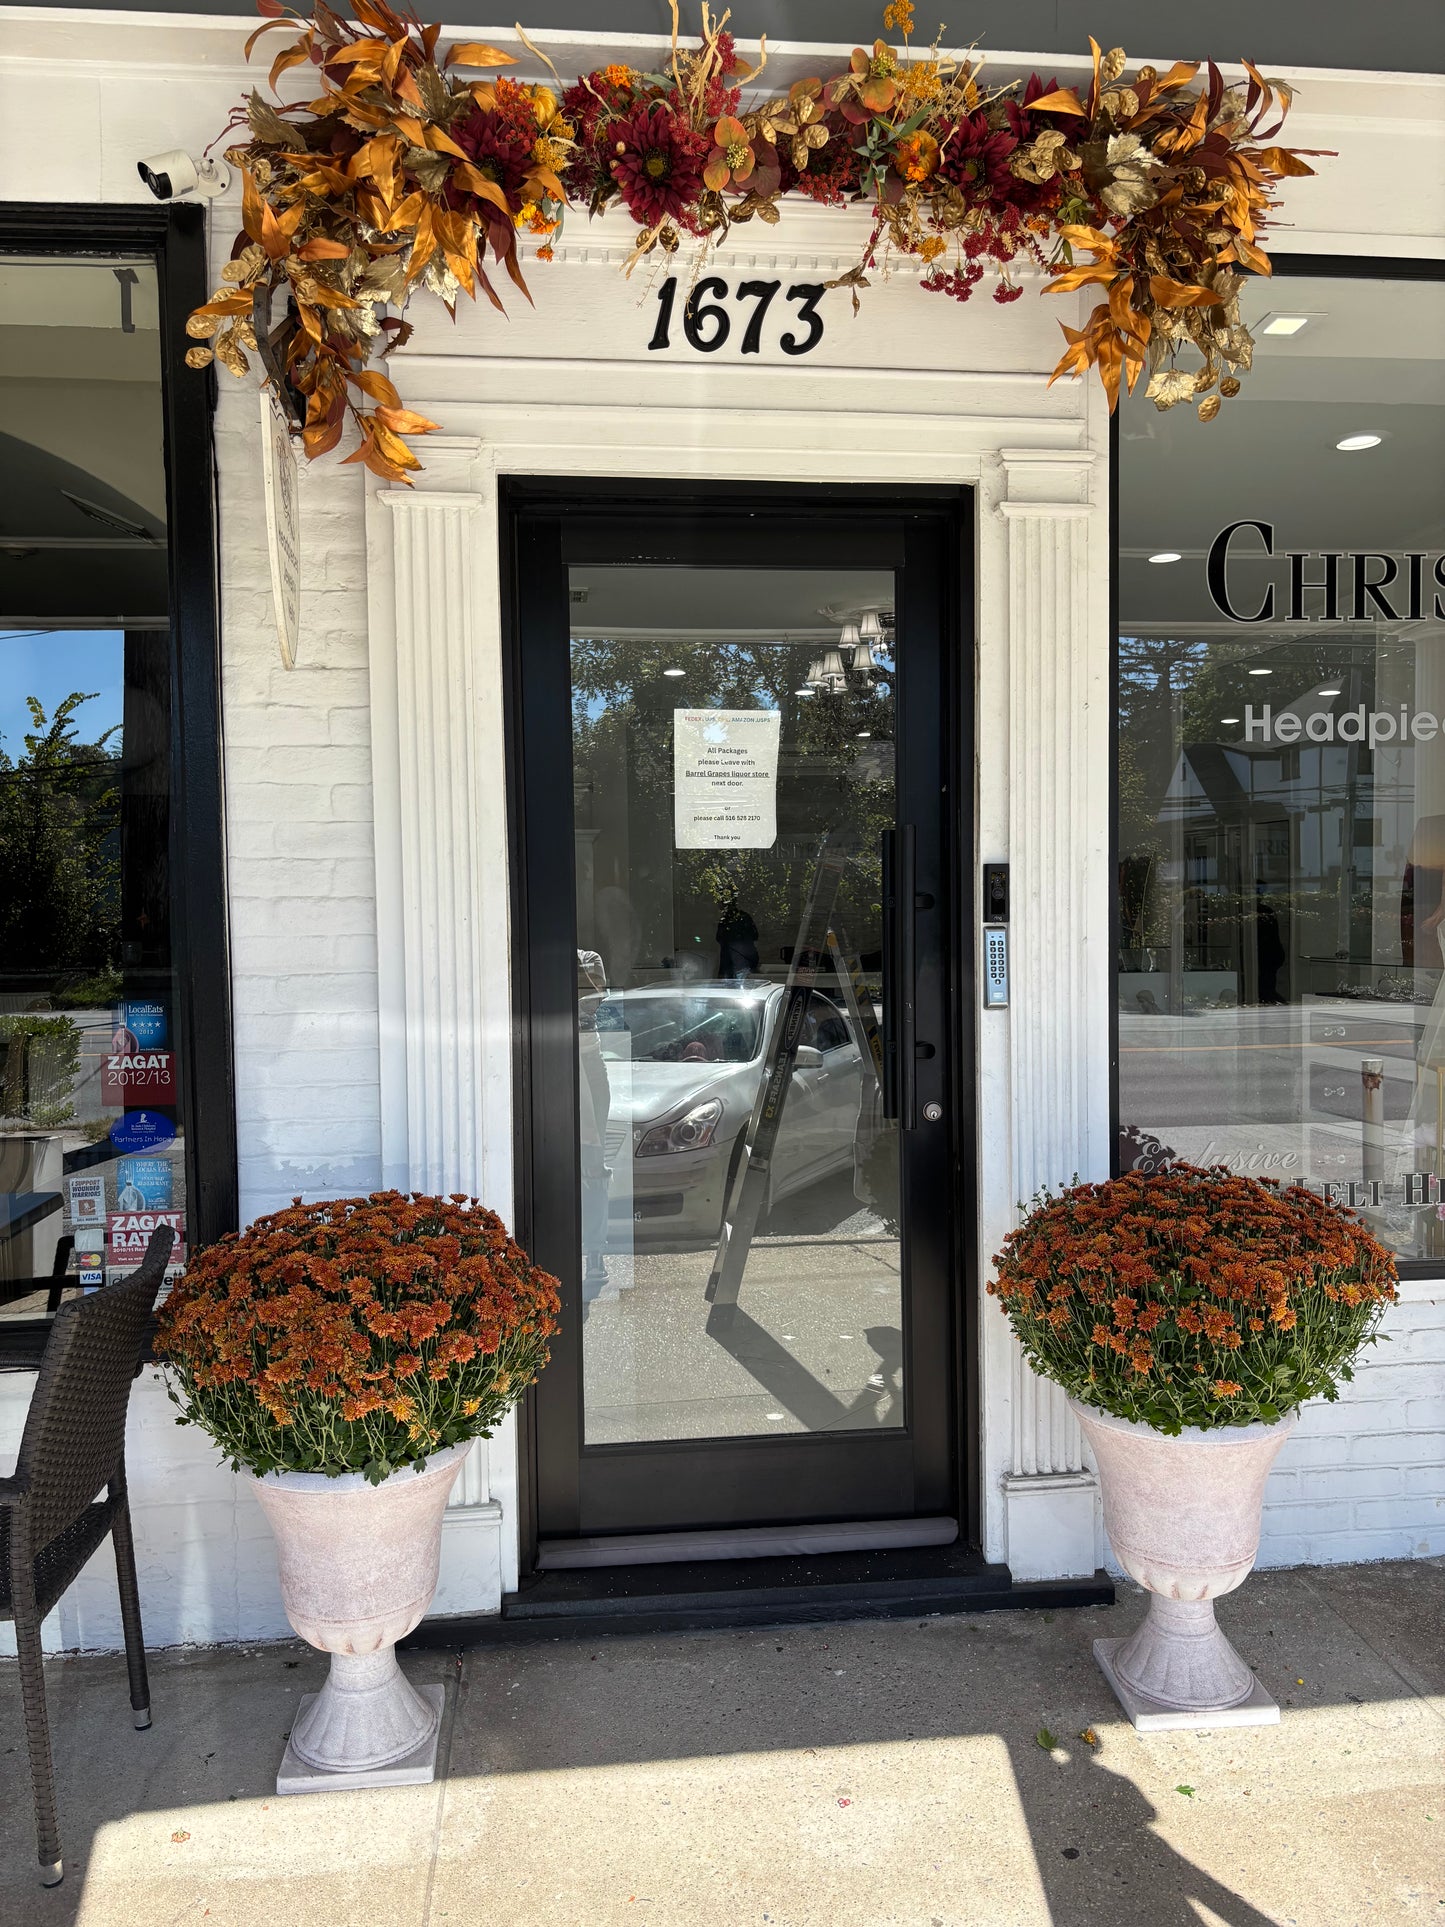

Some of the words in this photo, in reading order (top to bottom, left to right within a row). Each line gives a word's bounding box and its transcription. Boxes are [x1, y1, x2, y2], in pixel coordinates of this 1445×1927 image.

[648, 277, 826, 355] 1673
[1244, 703, 1445, 750] Headpie
[717, 747, 748, 755] Packages
[707, 770, 730, 778] Grapes
[731, 770, 751, 778] liquor
[128, 1004, 163, 1014] LocalEats
[107, 1054, 170, 1070] ZAGAT
[107, 1070, 171, 1086] 2012/13
[1132, 1141, 1299, 1175] Exlusive
[71, 1190, 101, 1198] WARRIORS
[111, 1214, 180, 1231] ZAGAT
[112, 1231, 180, 1248] RAT
[82, 1273, 102, 1281] VISA
